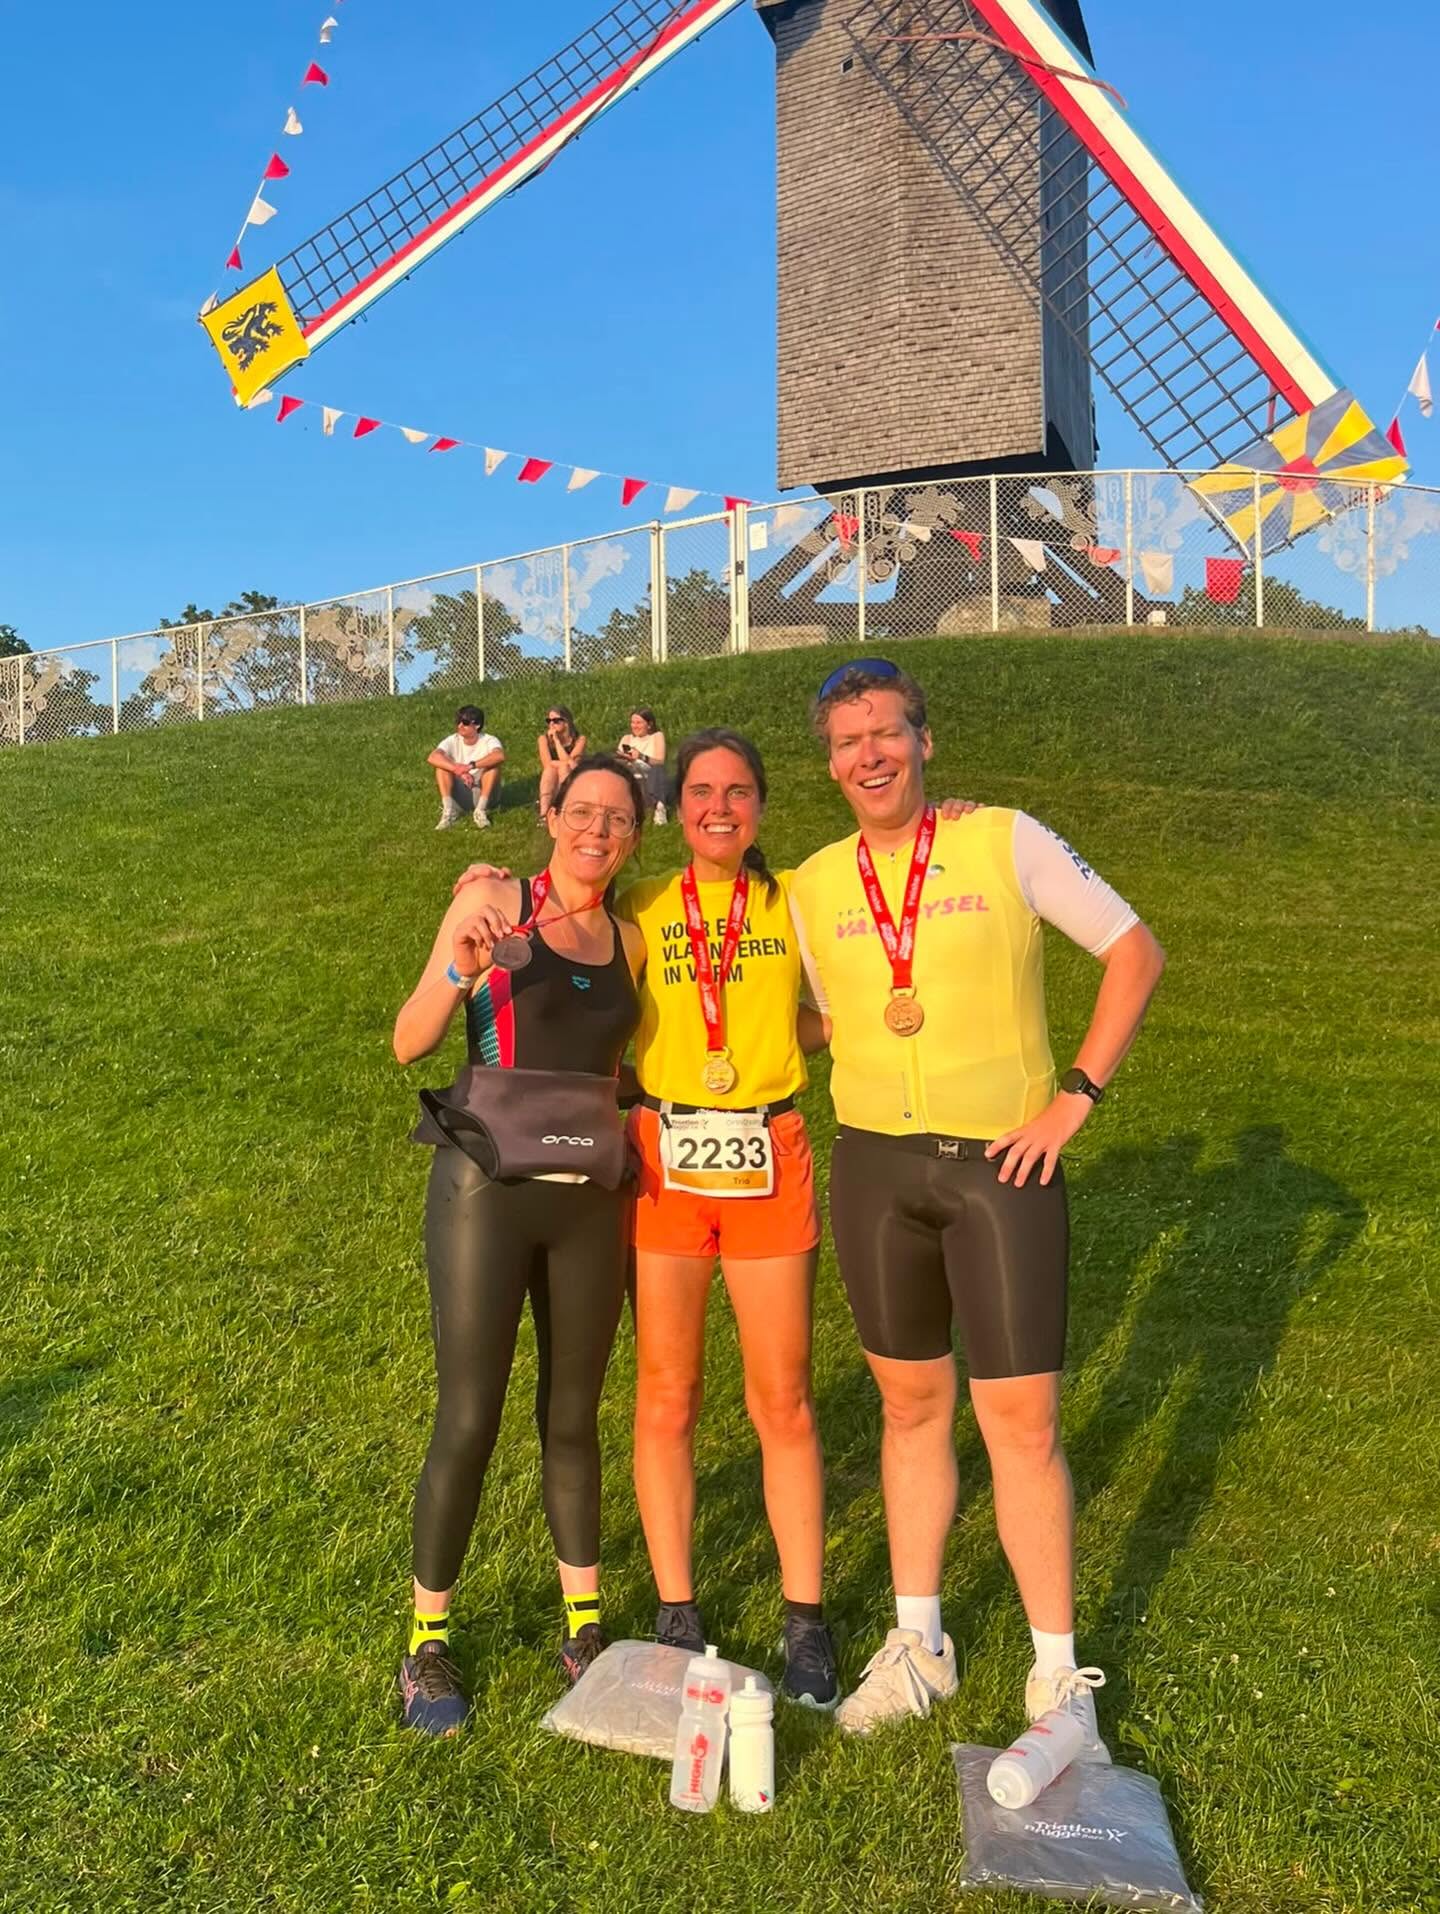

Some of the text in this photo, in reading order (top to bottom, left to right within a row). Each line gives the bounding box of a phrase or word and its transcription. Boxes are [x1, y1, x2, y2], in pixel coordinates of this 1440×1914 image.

[919, 894, 990, 919] YSEL
[661, 918, 752, 941] VOR EN
[663, 938, 787, 962] VLANEREN
[664, 964, 743, 985] IN VRM
[541, 1135, 594, 1147] orca
[677, 1137, 767, 1169] 2233
[733, 1177, 751, 1185] Trio
